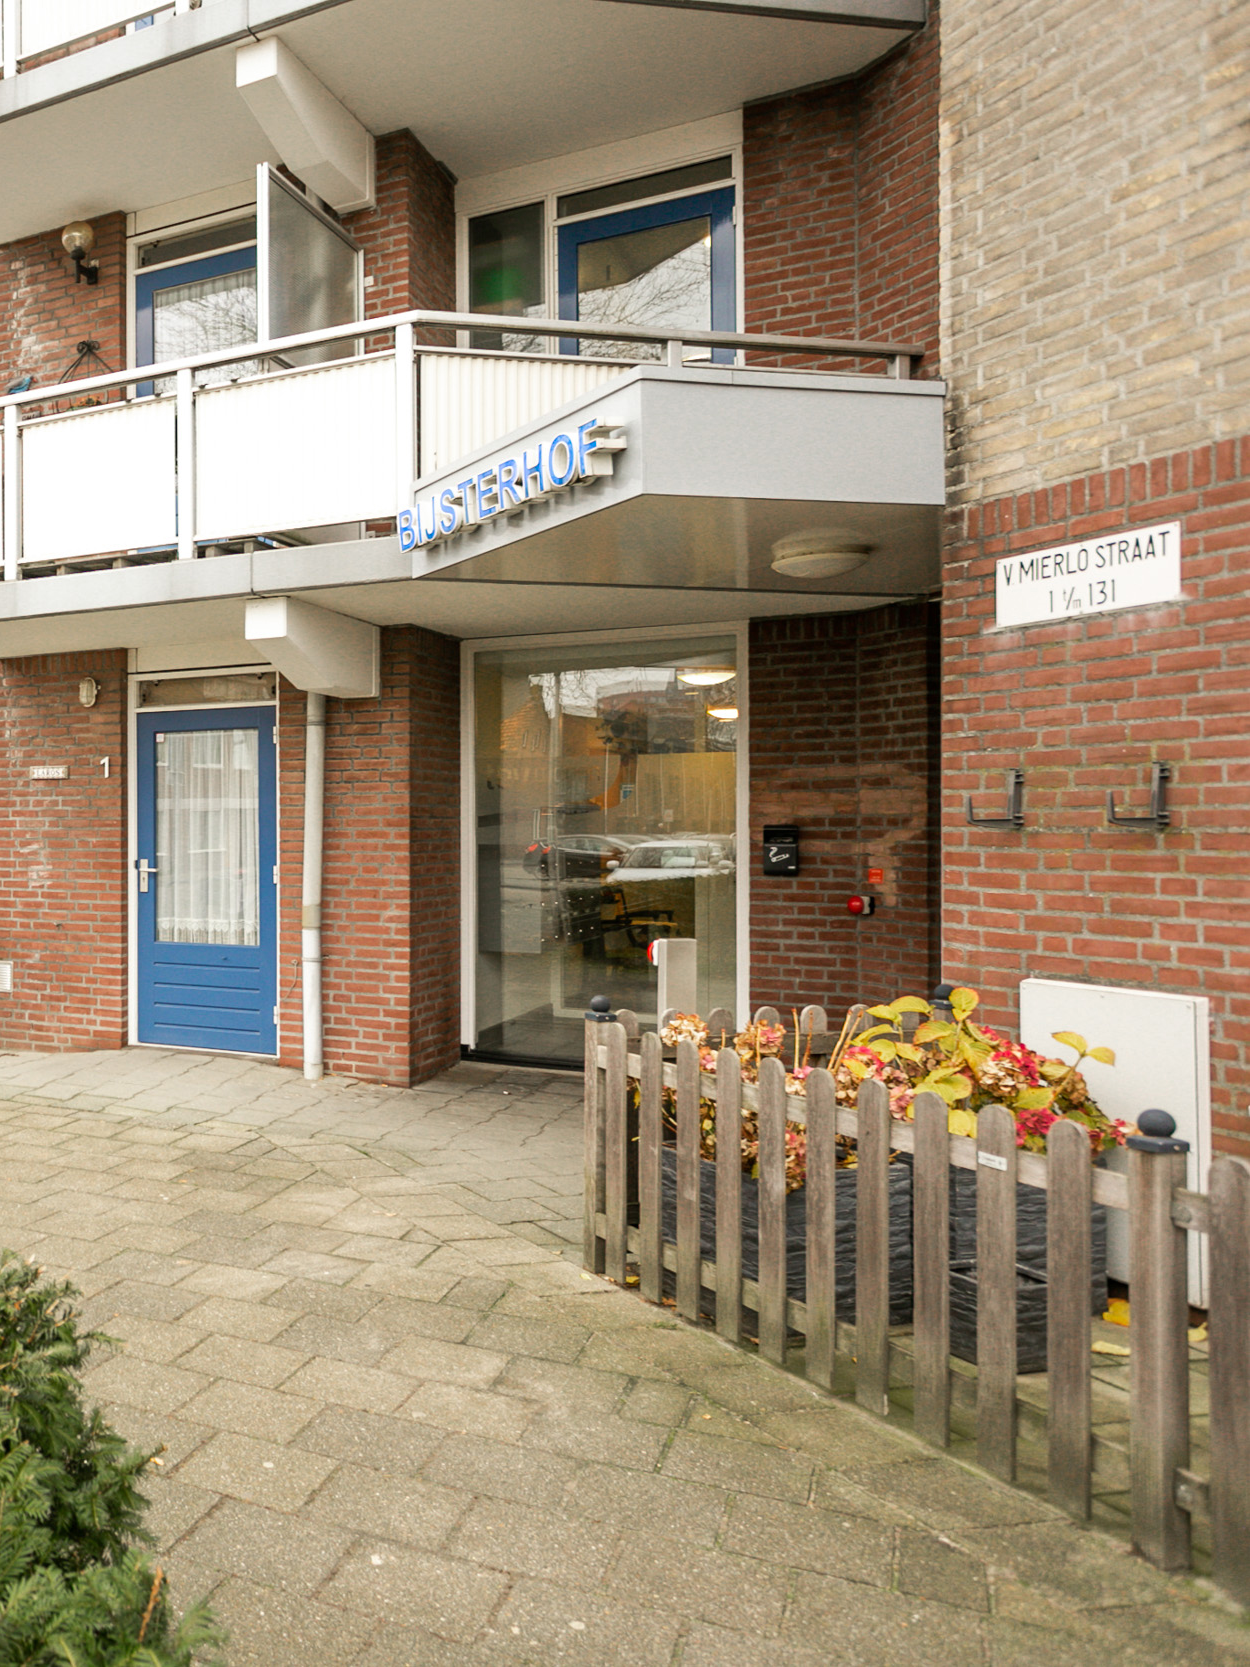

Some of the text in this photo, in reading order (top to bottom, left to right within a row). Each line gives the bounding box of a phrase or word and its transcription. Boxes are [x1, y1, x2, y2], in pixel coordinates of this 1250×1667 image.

[399, 418, 598, 553] BIJSTERHOF
[1019, 548, 1090, 583] MIERLO
[1095, 530, 1171, 569] STRAAT
[1049, 590, 1054, 613] 1
[1088, 579, 1116, 607] 131
[100, 756, 109, 779] 1
